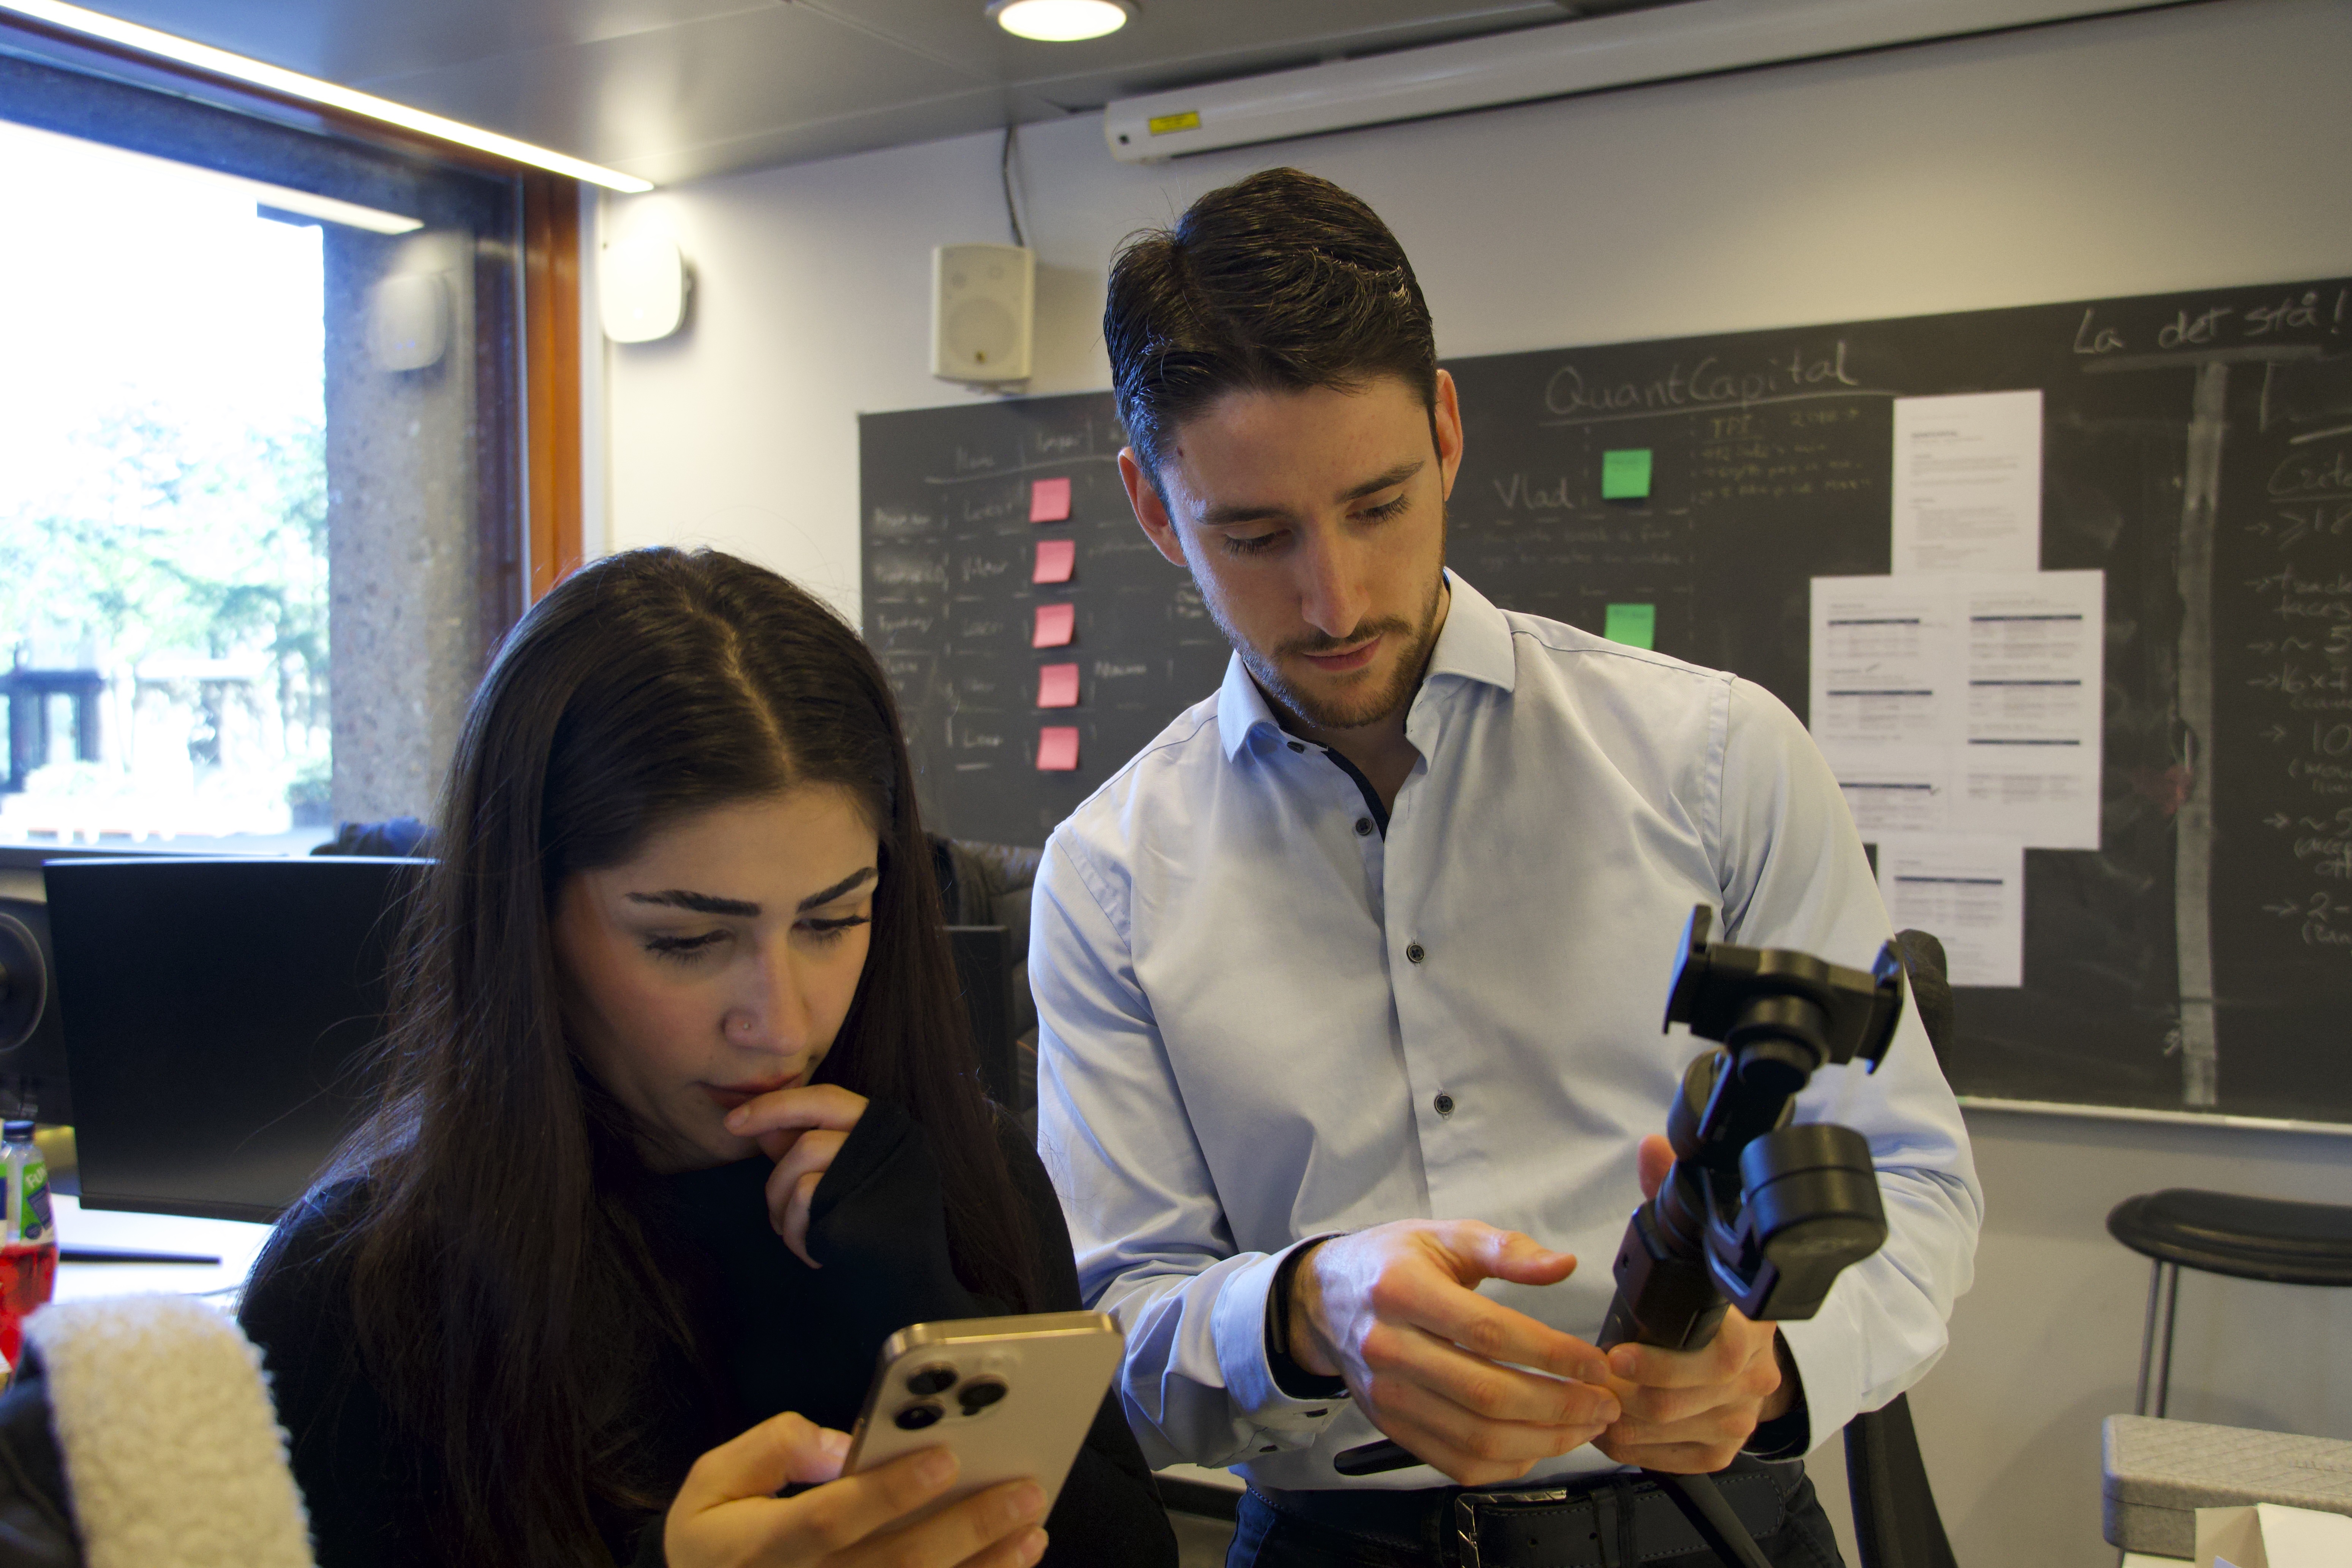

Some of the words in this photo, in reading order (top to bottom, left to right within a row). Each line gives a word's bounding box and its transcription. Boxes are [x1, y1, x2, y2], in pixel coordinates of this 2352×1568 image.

[2073, 307, 2123, 354] La
[2158, 309, 2233, 349] det
[1493, 473, 1576, 511] Vlad
